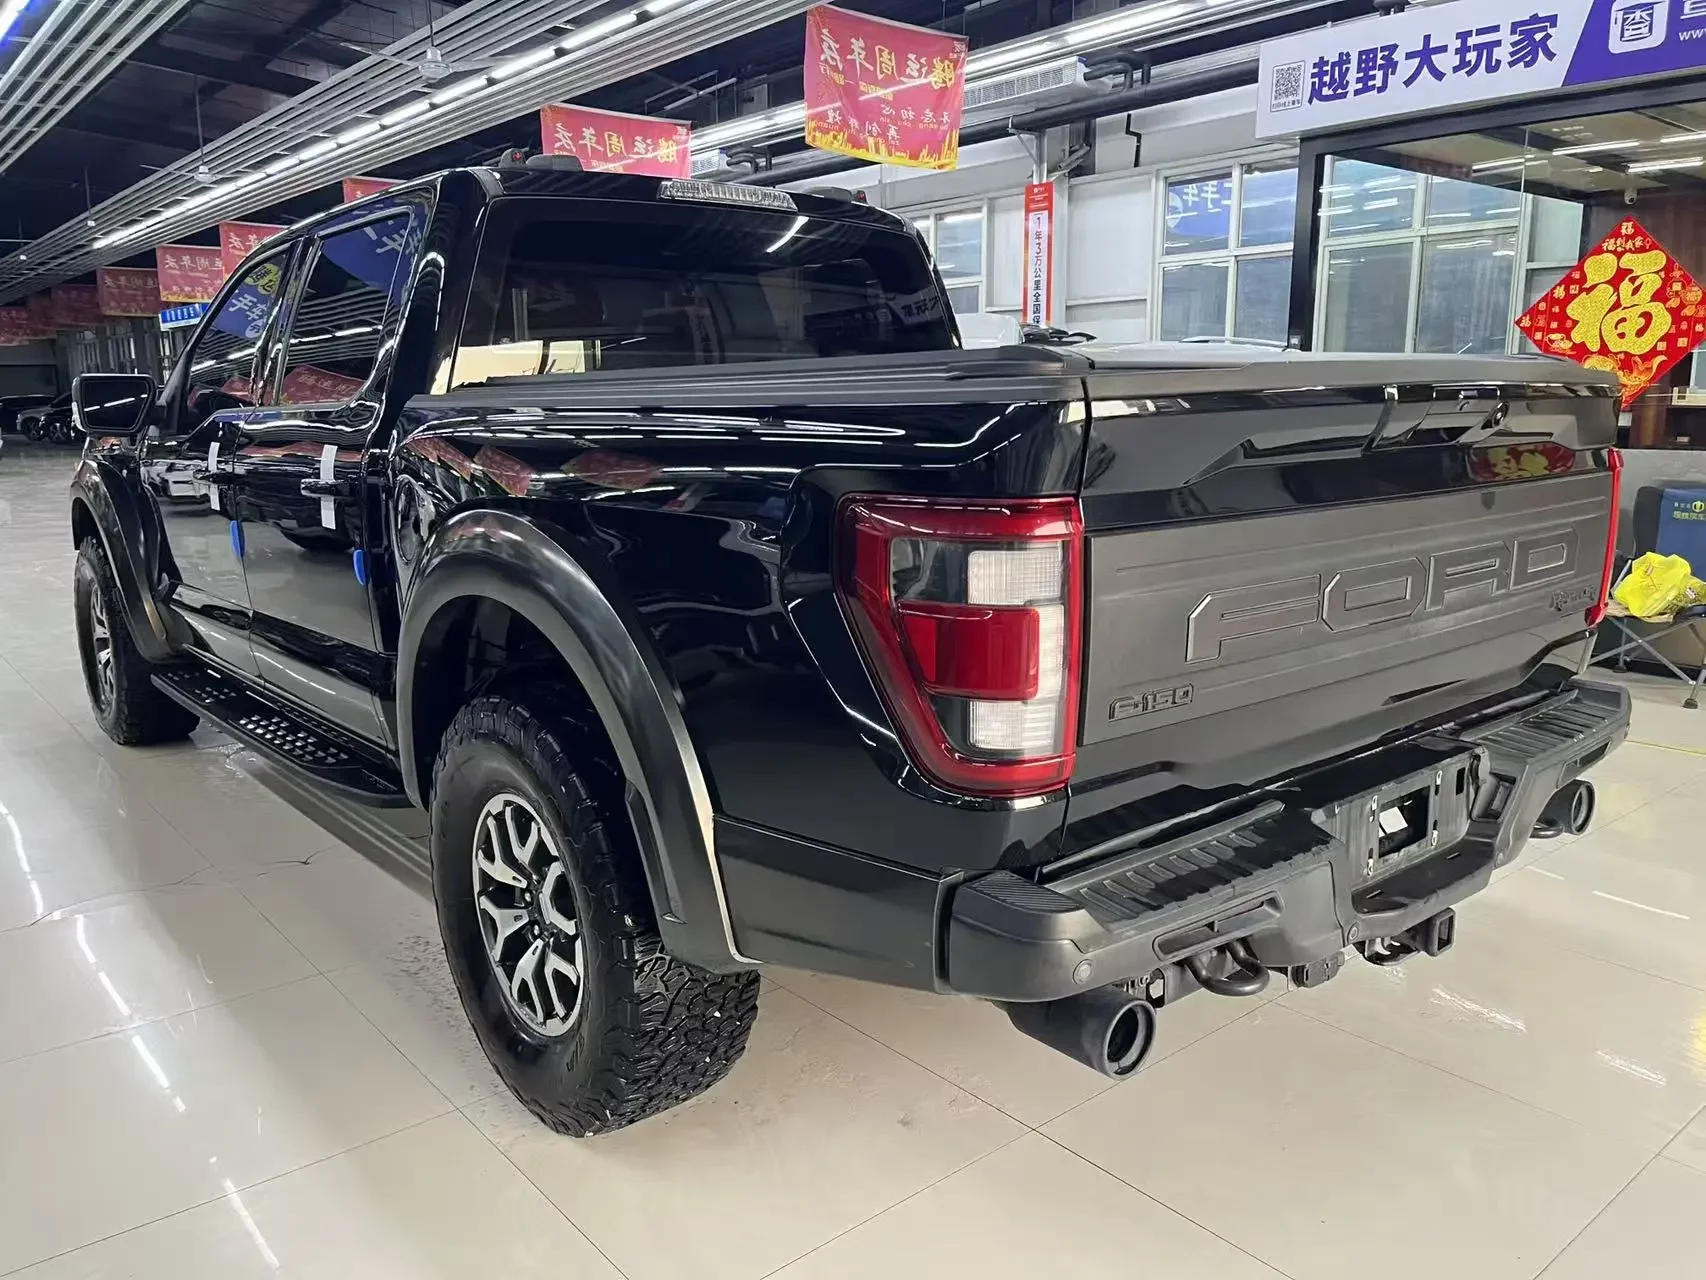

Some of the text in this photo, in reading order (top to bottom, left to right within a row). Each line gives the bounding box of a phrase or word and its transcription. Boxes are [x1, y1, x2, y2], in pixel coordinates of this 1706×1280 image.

[1307, 13, 1559, 105] 越野大玩家
[1566, 249, 1673, 355] 福
[1185, 527, 1578, 664] FORD
[1109, 683, 1194, 722] F-150
